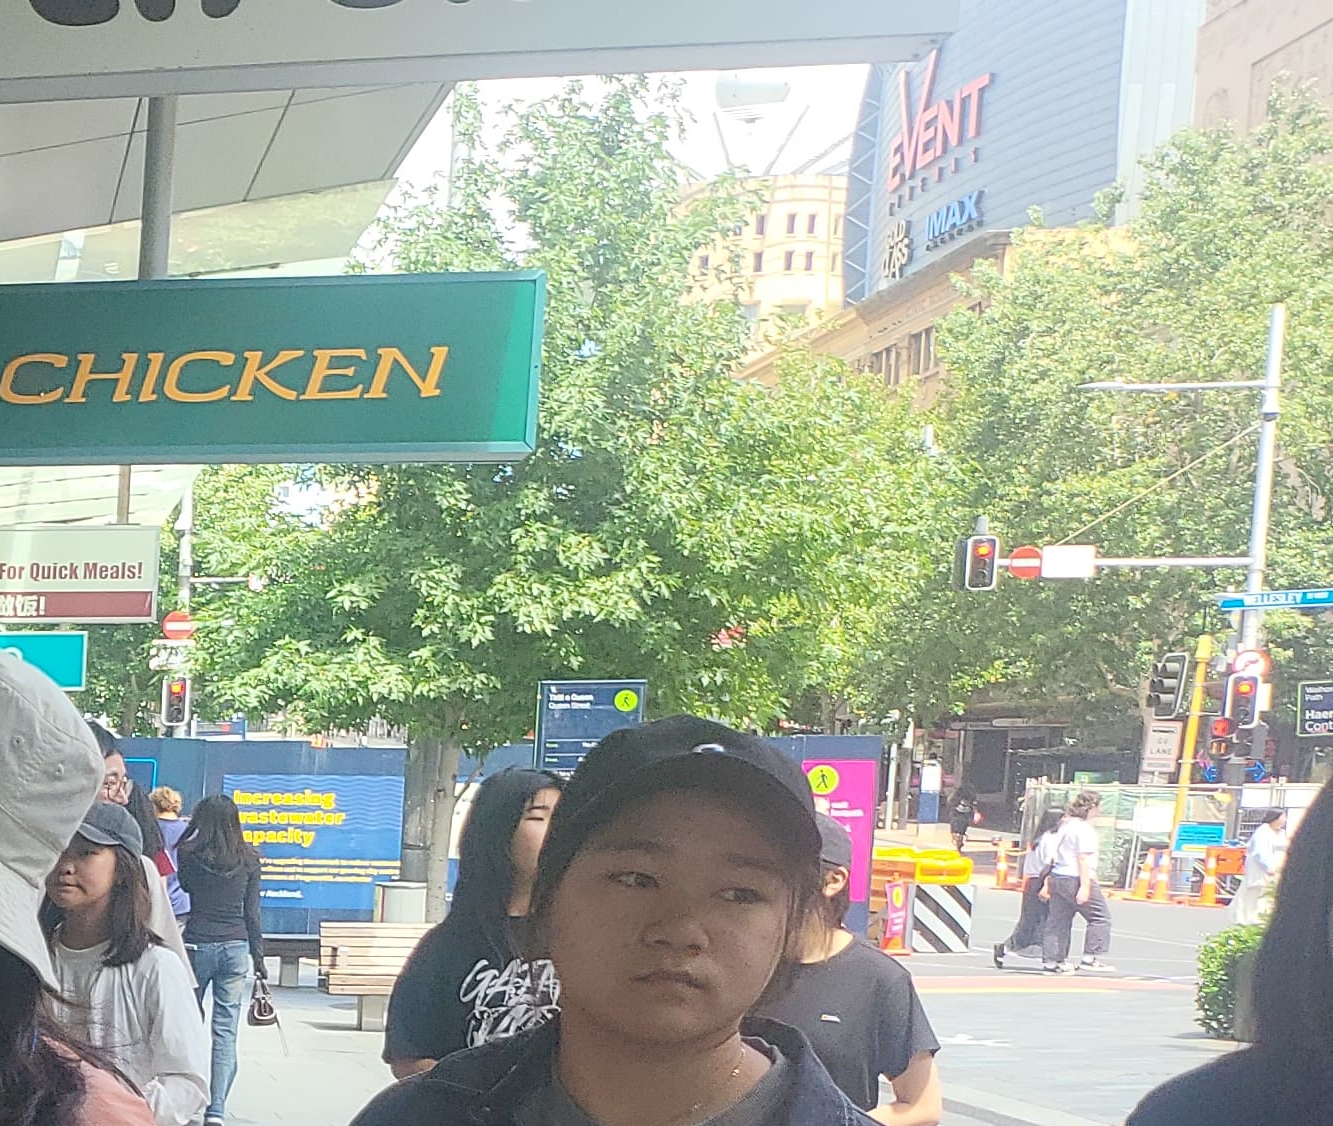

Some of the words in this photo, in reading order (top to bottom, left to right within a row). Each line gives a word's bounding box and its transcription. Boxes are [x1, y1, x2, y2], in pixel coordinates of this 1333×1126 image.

[887, 47, 991, 193] EVENT
[926, 190, 980, 241] IMAX
[30, 561, 79, 581] Quick
[83, 561, 144, 580] Meals!
[1244, 591, 1304, 608] ELLESLEY
[233, 789, 336, 810] Increasing
[242, 827, 316, 848] apacity
